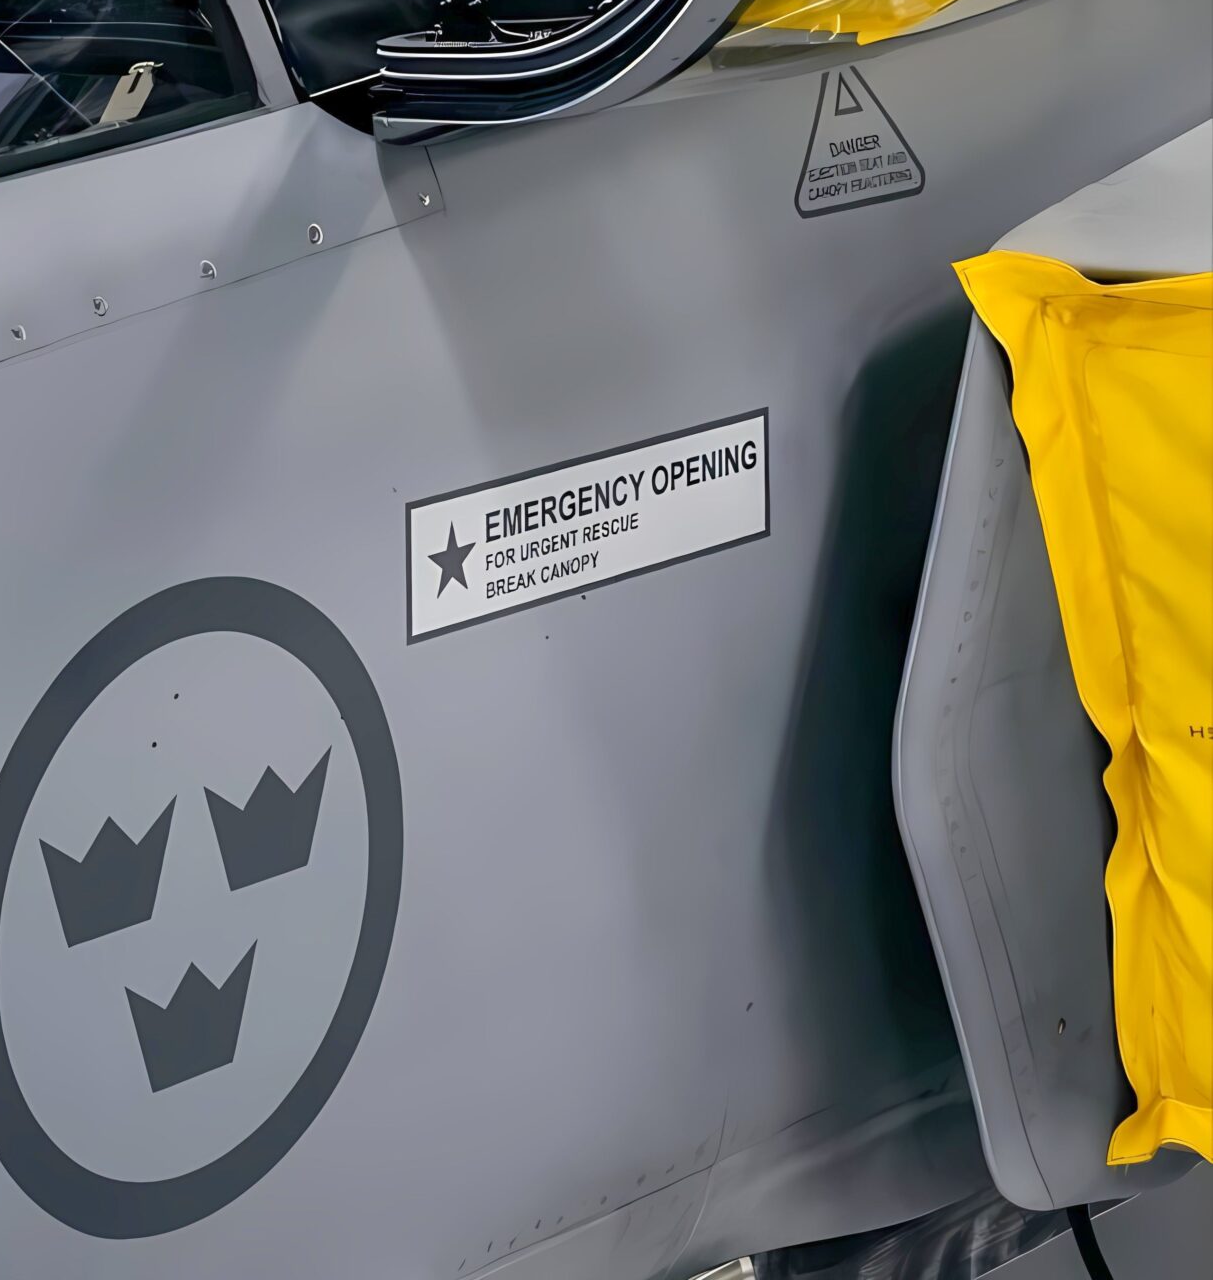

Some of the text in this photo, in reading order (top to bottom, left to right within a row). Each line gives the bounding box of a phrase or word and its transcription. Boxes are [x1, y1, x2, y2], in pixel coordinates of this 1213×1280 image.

[829, 134, 882, 158] DANGER
[485, 440, 758, 543] EMERGENCY OPENING
[485, 512, 639, 571] FOR URGENT RESCUE
[485, 551, 599, 599] BREAK CANOPY
